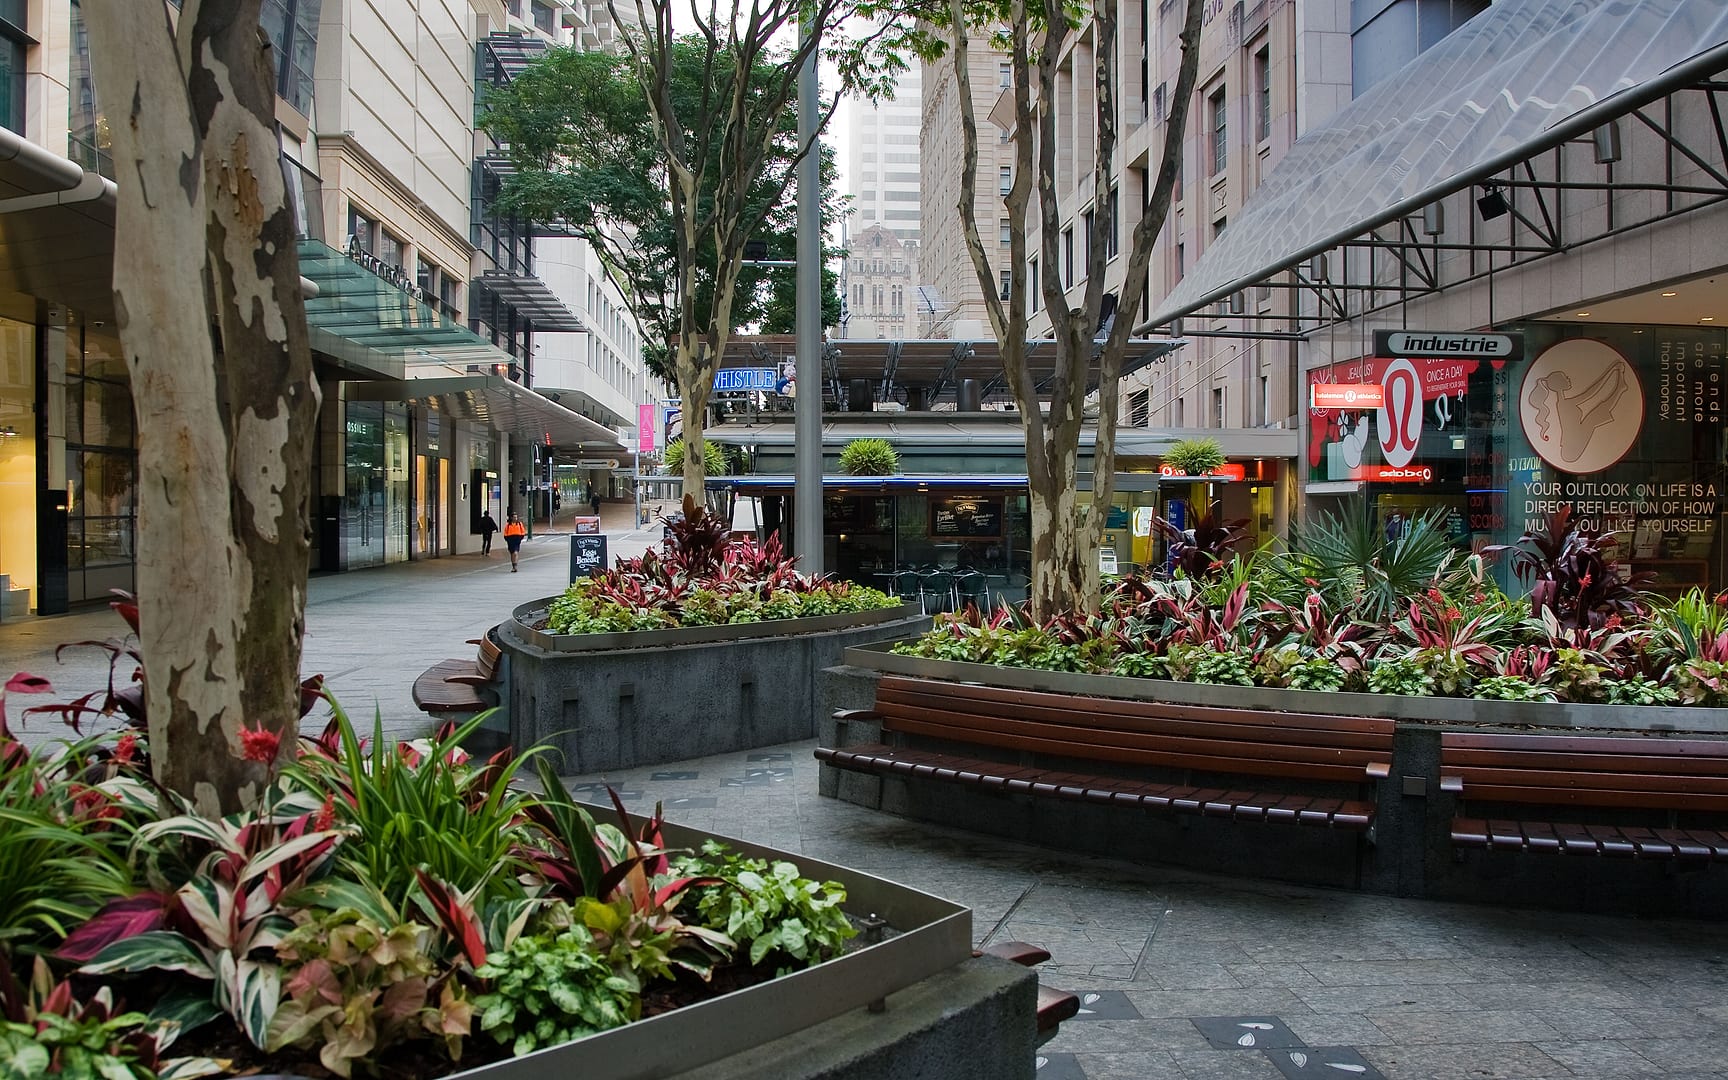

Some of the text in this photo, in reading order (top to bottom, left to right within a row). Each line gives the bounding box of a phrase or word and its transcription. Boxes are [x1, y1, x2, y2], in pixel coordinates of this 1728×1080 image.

[1404, 336, 1498, 352] industrie
[1426, 365, 1464, 383] ONCE A DAY
[1659, 342, 1672, 420] than money.
[1675, 342, 1687, 422] important
[1694, 342, 1703, 422] are more
[1524, 482, 1716, 497] YOUR OUTLOOK ON LIFE IS A
[1525, 500, 1715, 515] DIRECT REFLECTION OF HOW
[1607, 519, 1636, 533] LIKE
[1643, 519, 1713, 533] YOURSELF
